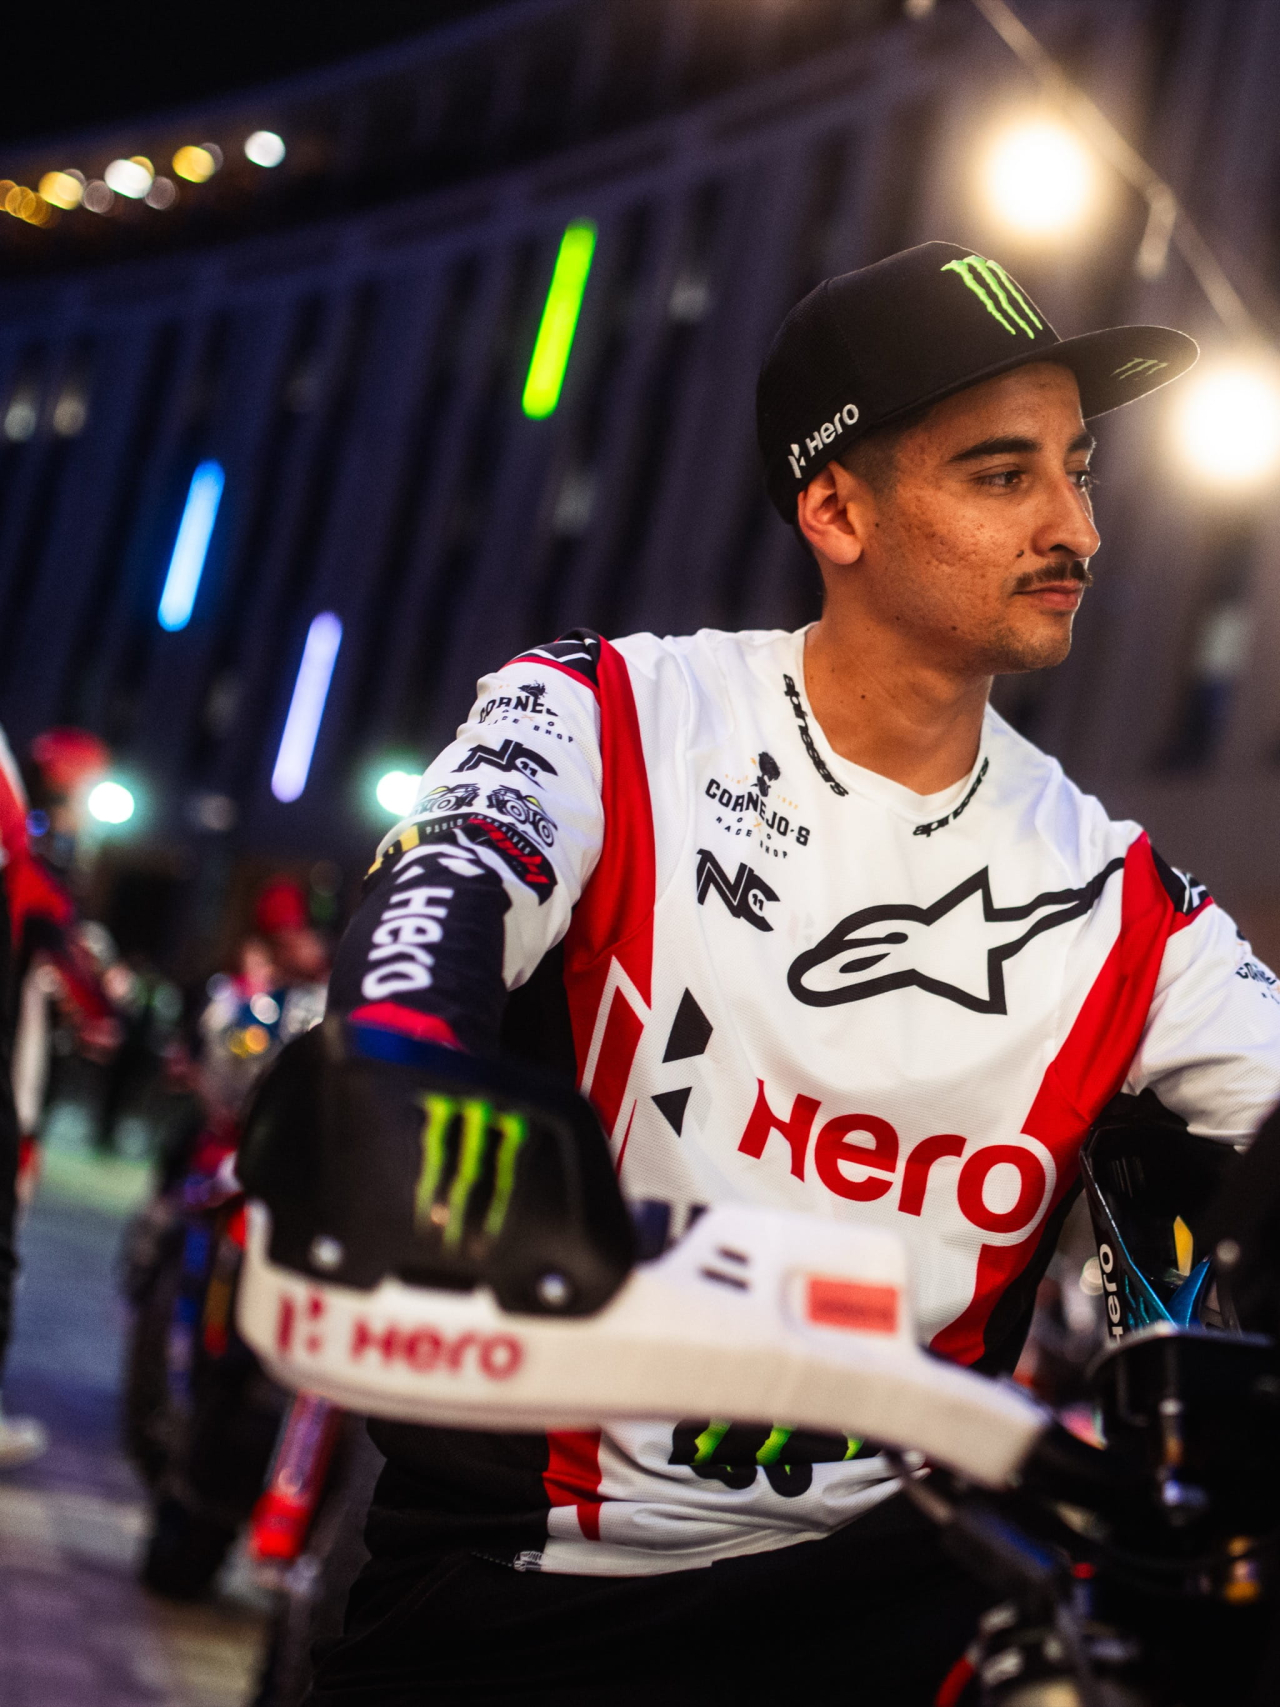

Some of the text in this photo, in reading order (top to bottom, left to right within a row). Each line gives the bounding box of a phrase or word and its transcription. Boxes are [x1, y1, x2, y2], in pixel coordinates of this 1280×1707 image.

[805, 404, 859, 457] Hero
[361, 886, 455, 1000] Hero
[737, 1077, 1046, 1234] Hero
[350, 1316, 523, 1382] Hero
